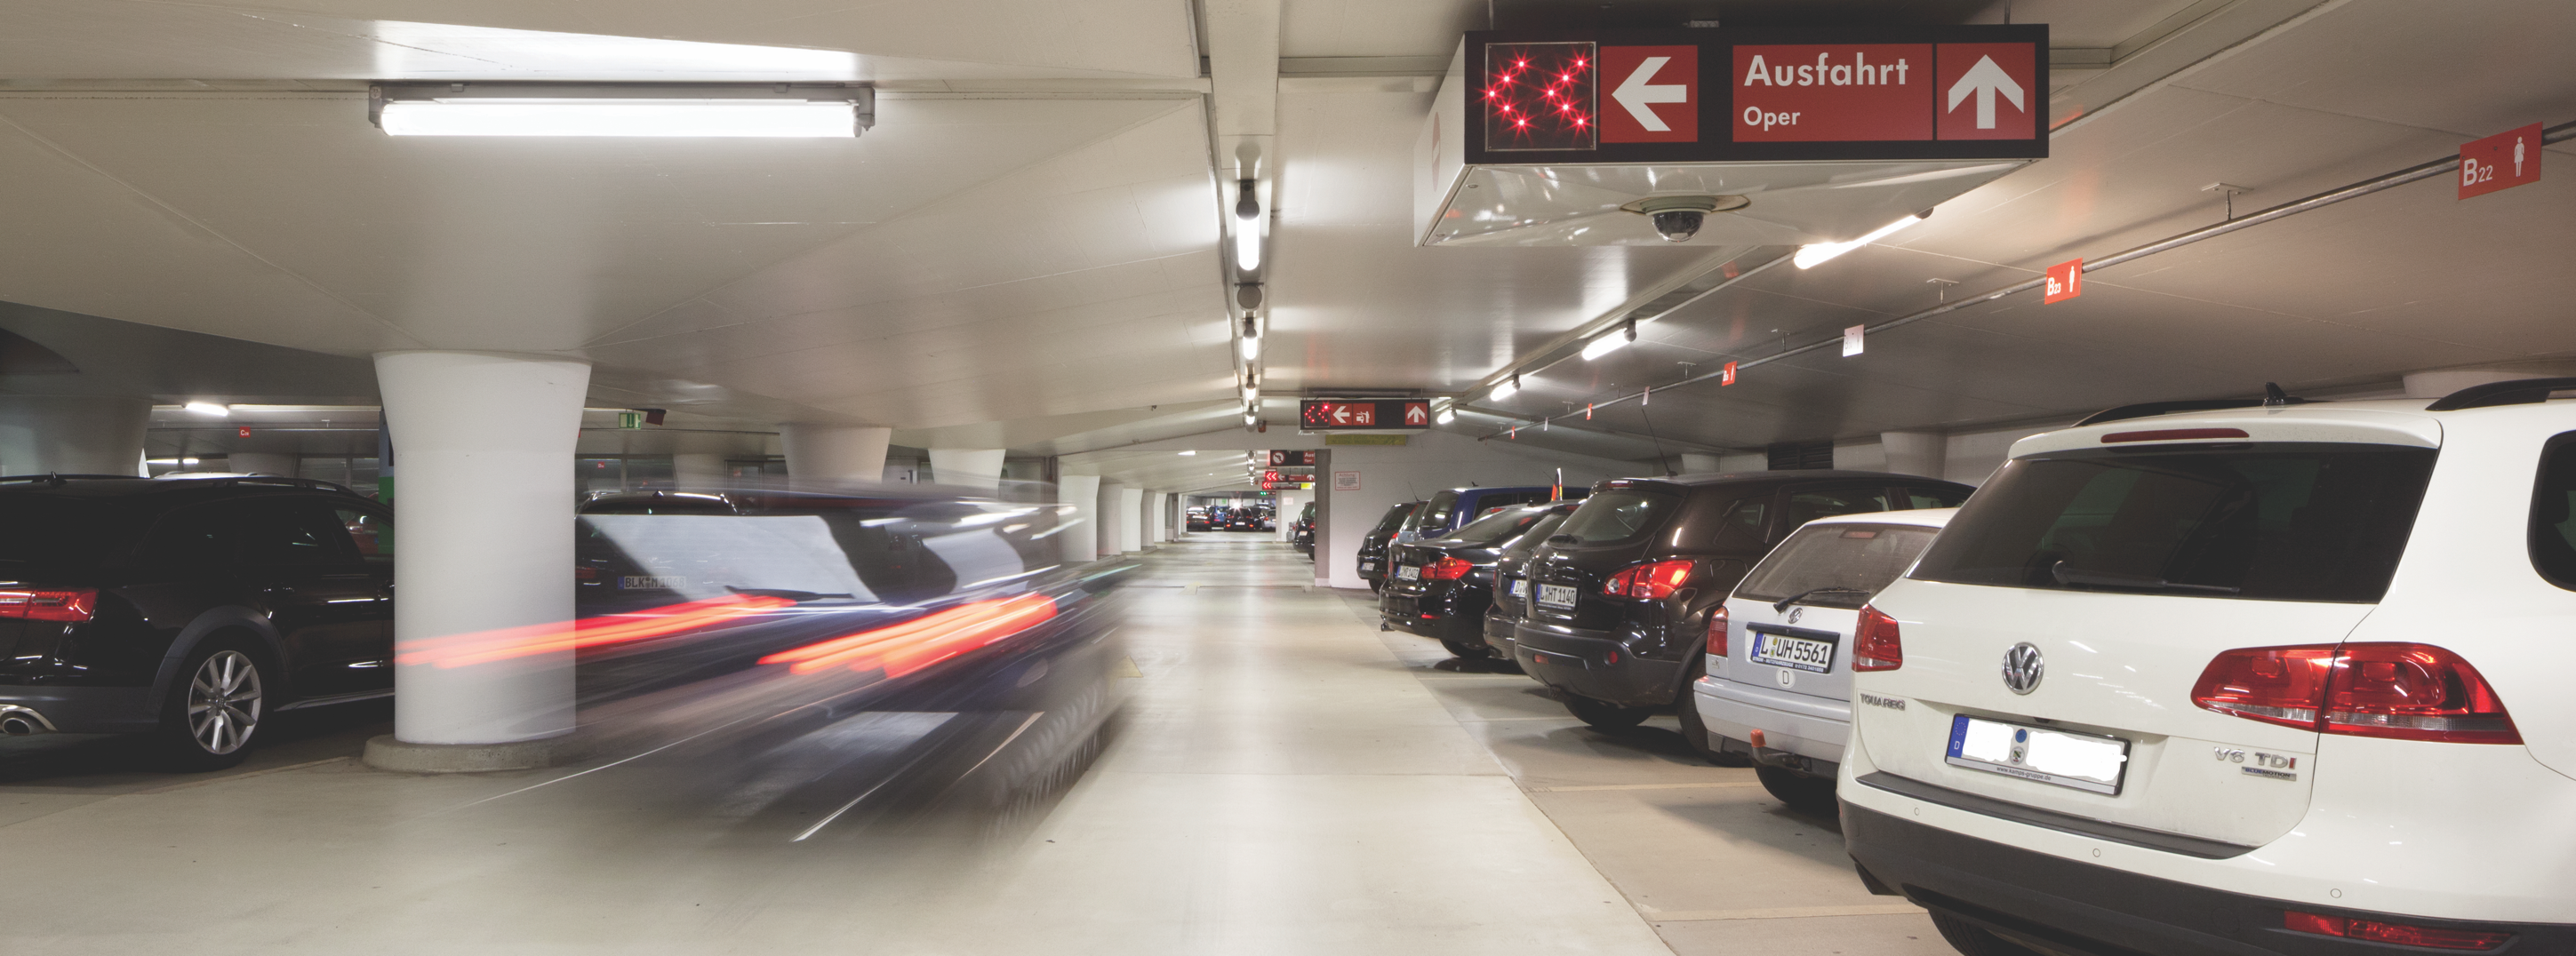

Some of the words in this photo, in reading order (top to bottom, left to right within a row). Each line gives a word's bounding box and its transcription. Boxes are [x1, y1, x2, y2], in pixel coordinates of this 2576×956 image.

[1744, 52, 1908, 86] Ausfahrt
[1743, 106, 1801, 131] Oper
[2463, 158, 2493, 187] B22
[625, 577, 645, 588] BLK
[1540, 586, 1545, 601] L
[1548, 586, 1558, 602] HT
[1557, 587, 1575, 604] 1140
[1761, 636, 1769, 655] L
[1776, 638, 1795, 659] UH
[1794, 641, 1828, 665] 5561
[1782, 670, 1789, 684] D
[1860, 693, 1906, 712] TOUAREG
[1954, 740, 1960, 750] D
[2214, 746, 2245, 763] V6
[2255, 752, 2297, 769] TDI
[1996, 766, 2052, 781] www.kamps-gruppe.de
